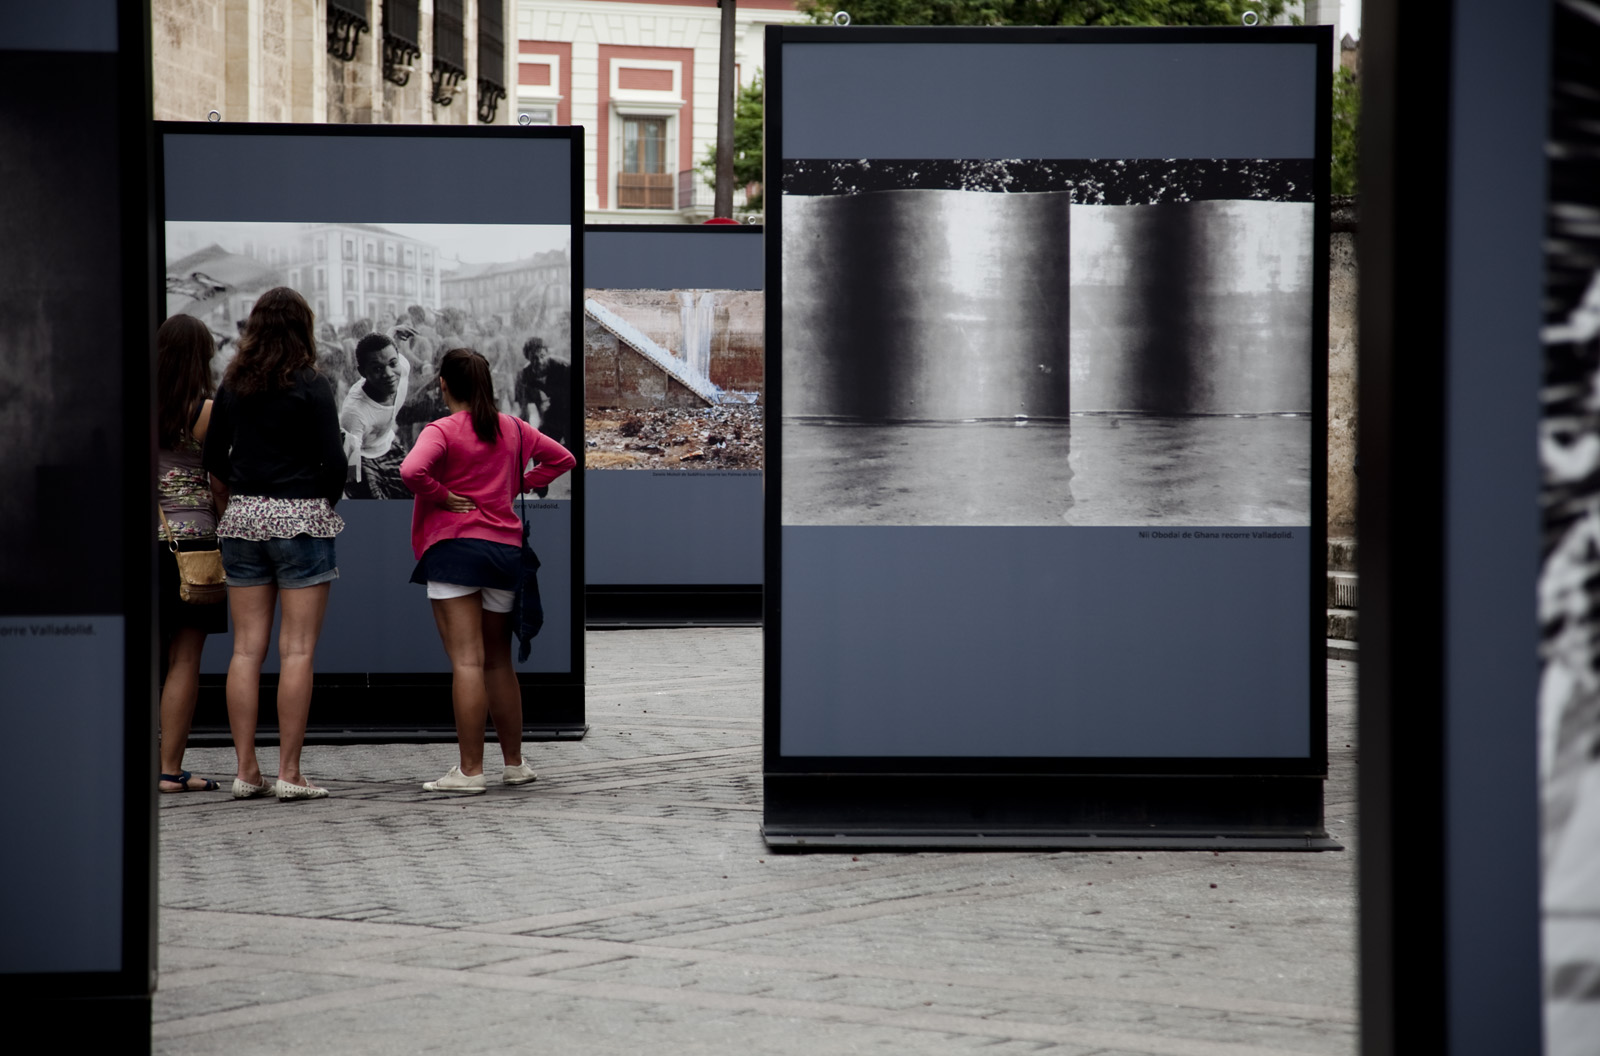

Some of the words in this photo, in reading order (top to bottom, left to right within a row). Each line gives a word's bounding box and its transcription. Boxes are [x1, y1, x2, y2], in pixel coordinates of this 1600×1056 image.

[1138, 531, 1150, 539] Nii
[1151, 531, 1180, 539] Obodai
[1182, 531, 1193, 539] de
[1194, 531, 1220, 539] Ghana
[1252, 531, 1295, 539] Valladolid.
[29, 623, 97, 637] Valladolid.
